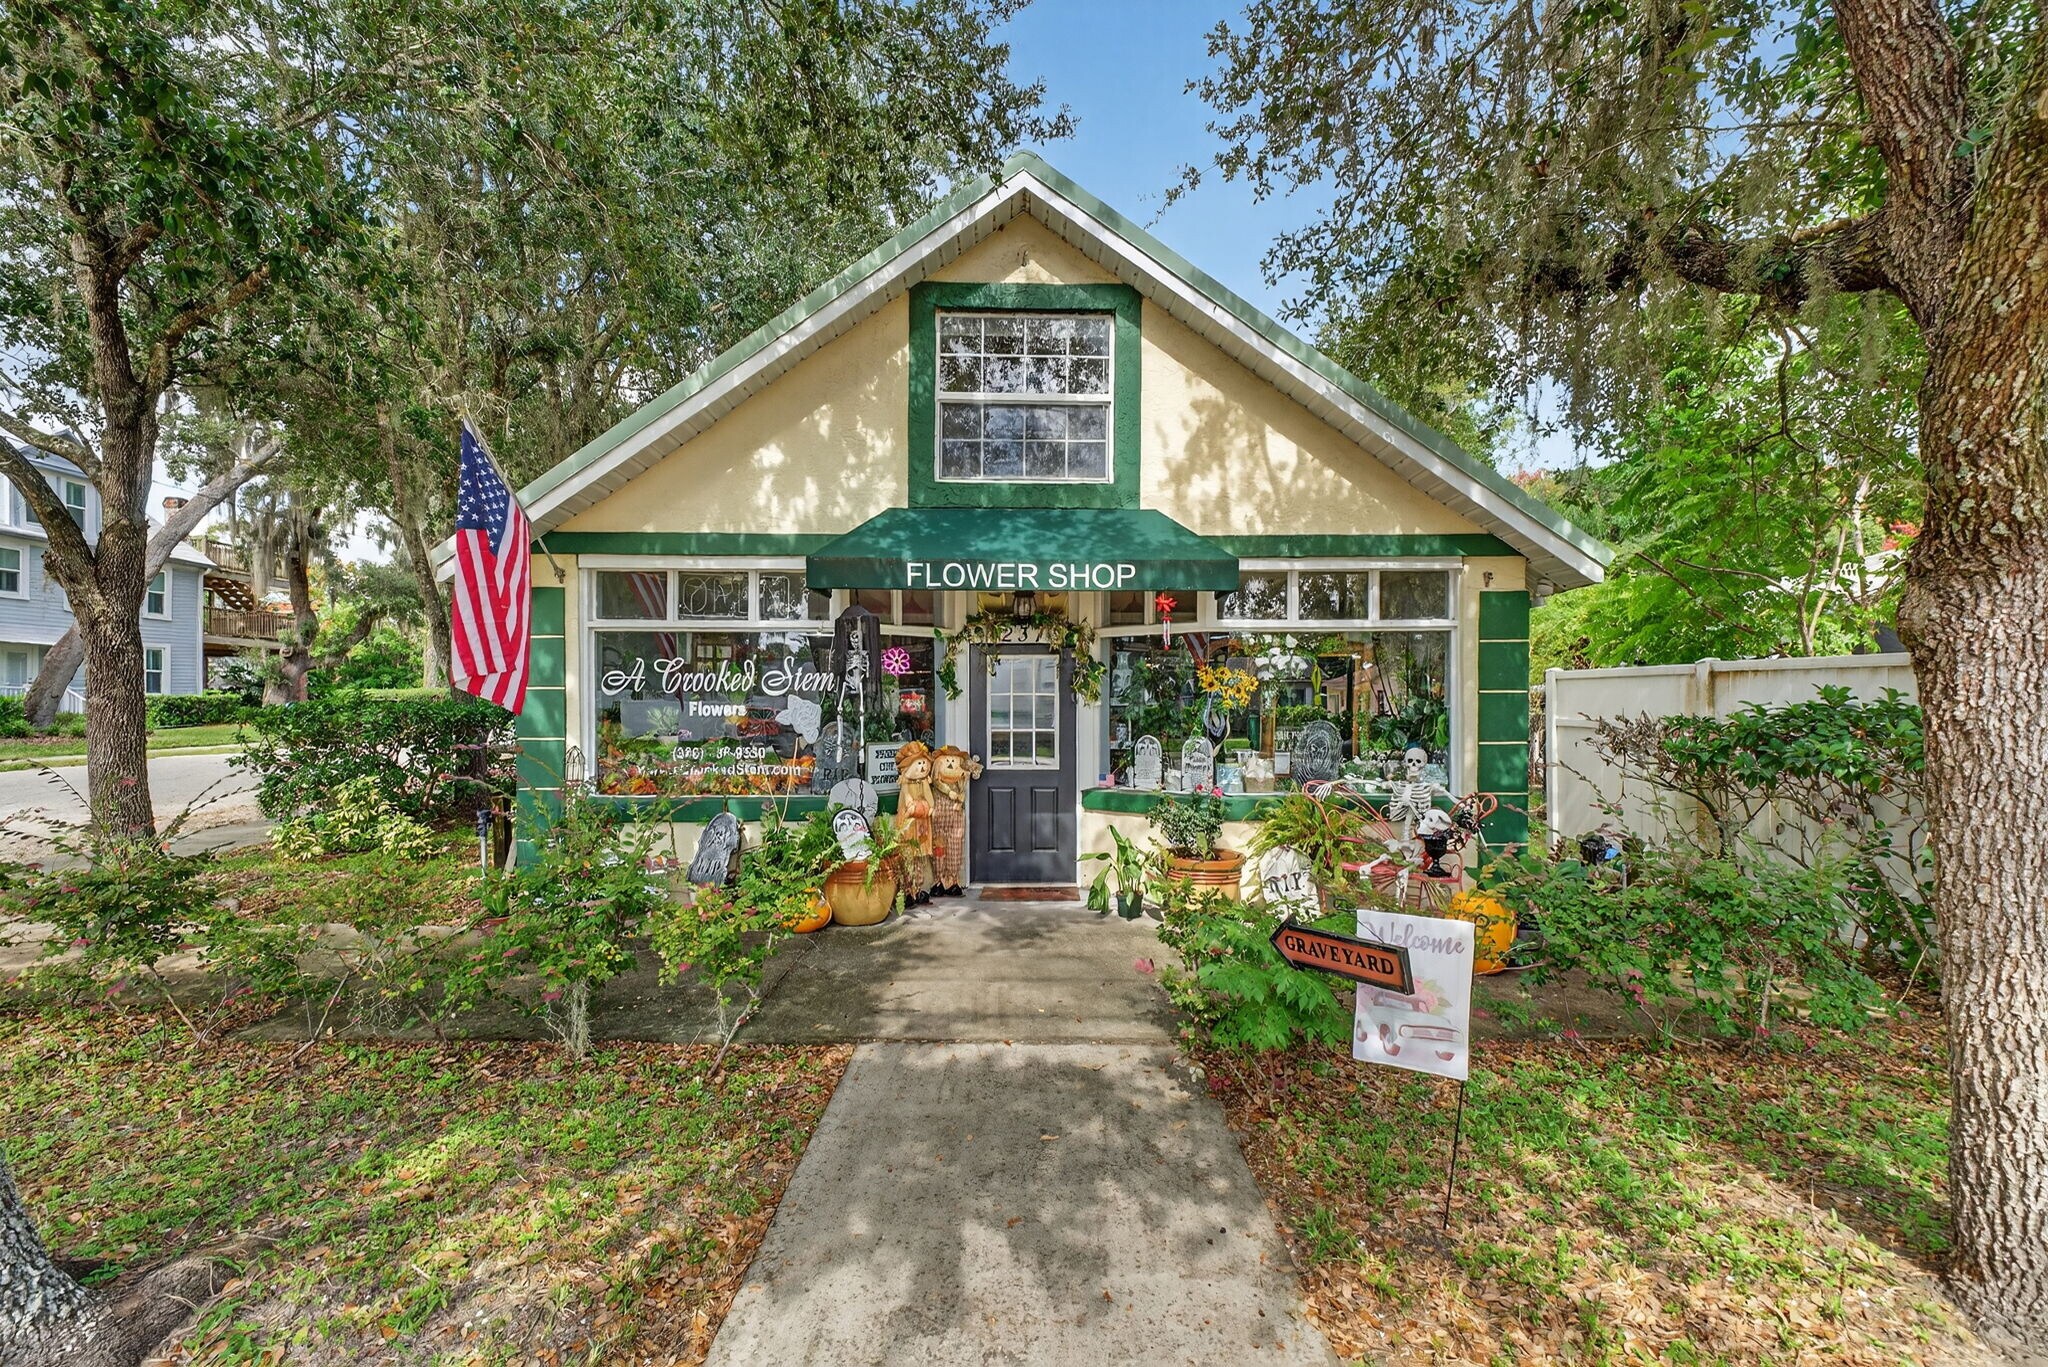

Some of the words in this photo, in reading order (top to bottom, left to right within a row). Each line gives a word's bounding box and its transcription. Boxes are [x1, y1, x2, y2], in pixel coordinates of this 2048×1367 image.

[907, 562, 1039, 588] FLOWER
[1048, 563, 1136, 588] SHOP
[601, 657, 646, 696] A
[653, 653, 756, 695] Crooked
[761, 656, 834, 697] Stem
[688, 701, 747, 718] Flowers
[1361, 921, 1466, 955] Welcome
[1285, 935, 1395, 976] GRAVEYARD
